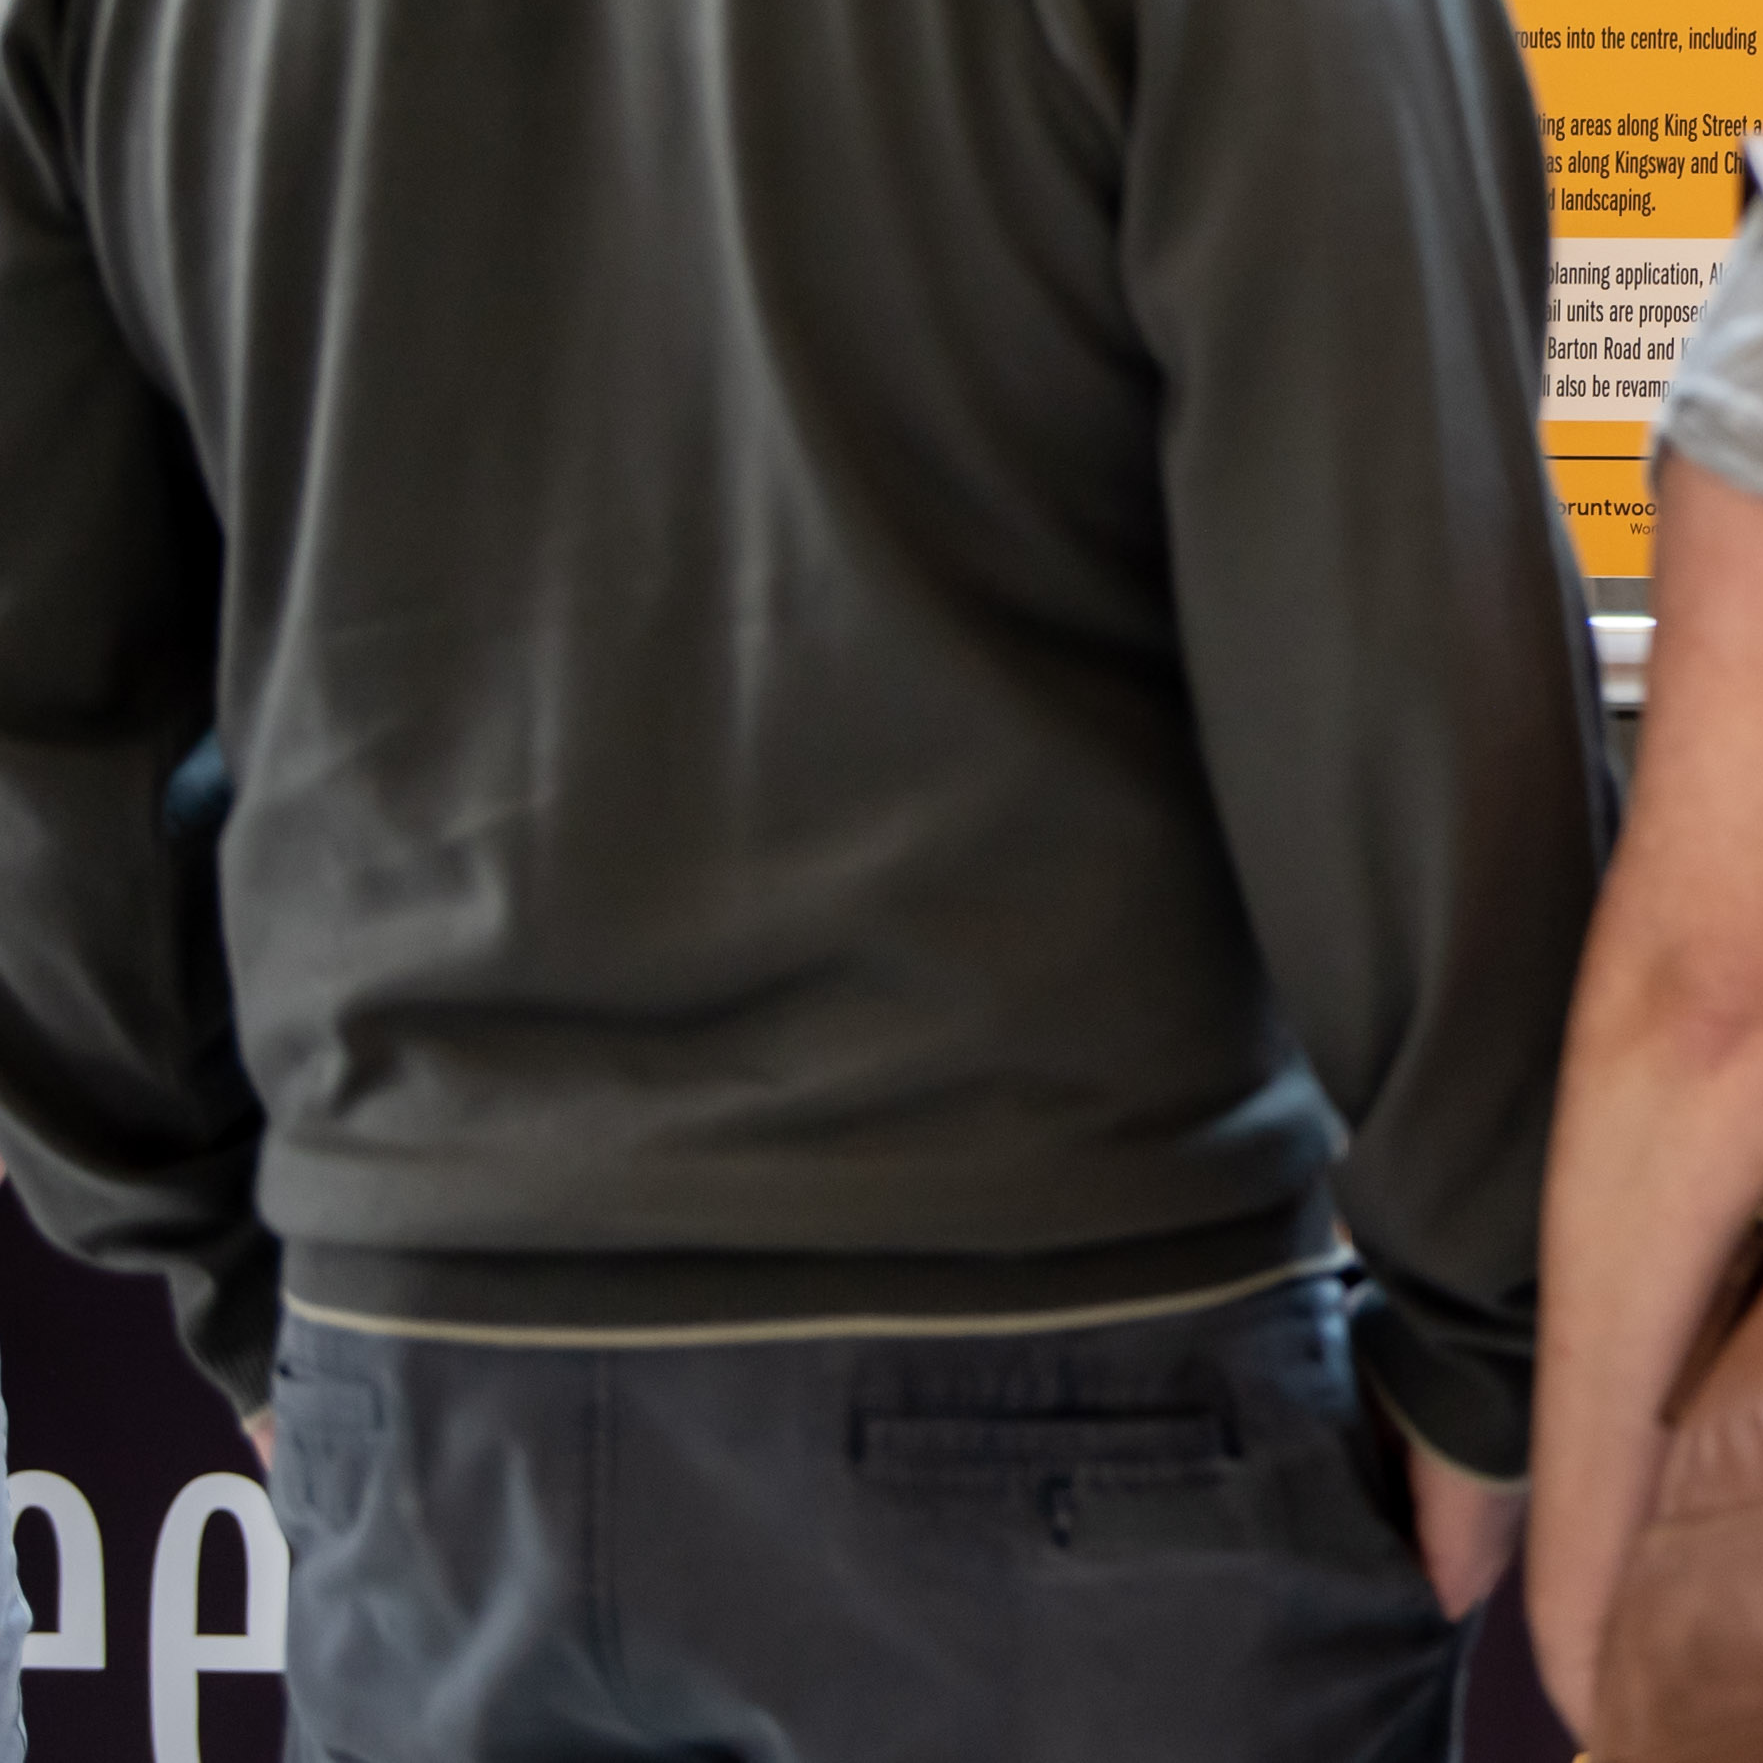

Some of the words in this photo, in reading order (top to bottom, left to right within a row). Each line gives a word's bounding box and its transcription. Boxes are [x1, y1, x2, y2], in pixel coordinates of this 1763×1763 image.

[1567, 26, 1595, 49] into
[1601, 26, 1625, 49] the
[1630, 28, 1682, 53] centre,
[1689, 26, 1756, 55] including
[1570, 118, 1611, 135] areas
[1617, 113, 1658, 141] along
[1664, 113, 1697, 142] King
[1702, 113, 1747, 136] Street
[1615, 262, 1703, 290] application,
[1554, 498, 1658, 518] runtwoo
